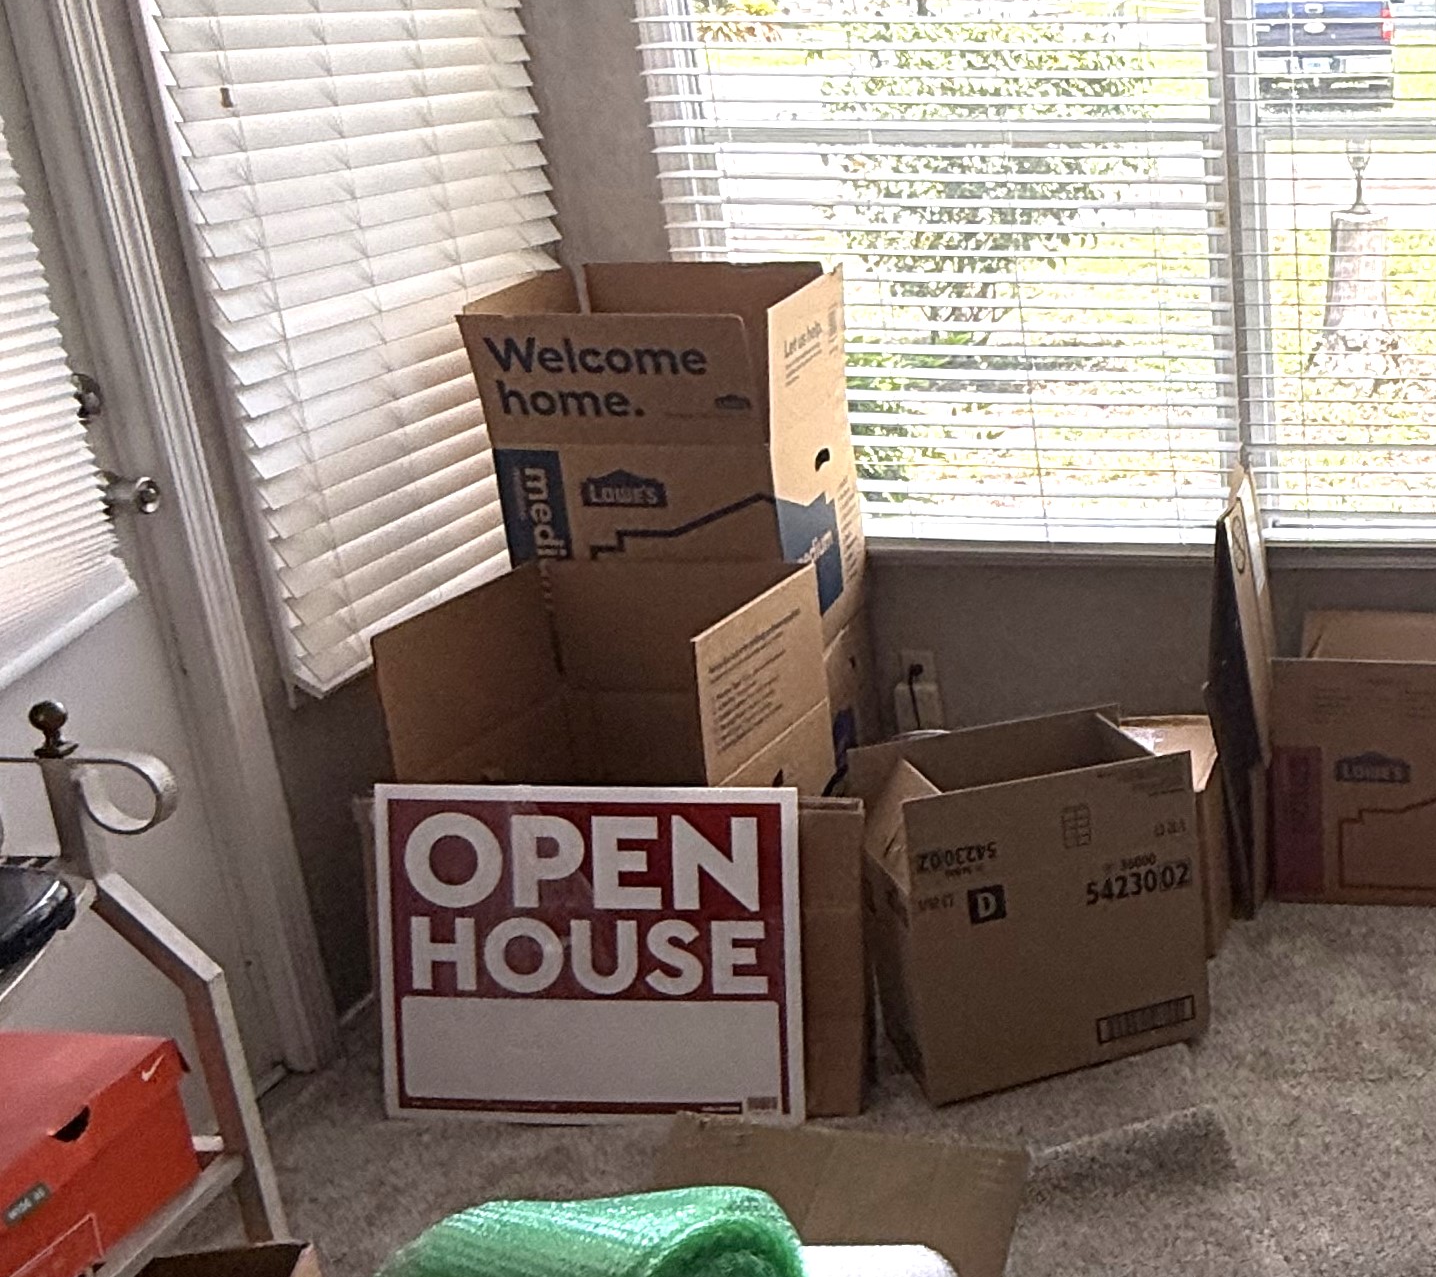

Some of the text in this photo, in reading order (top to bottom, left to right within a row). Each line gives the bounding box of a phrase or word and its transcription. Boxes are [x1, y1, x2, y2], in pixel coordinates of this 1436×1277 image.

[484, 336, 708, 377] Welcome
[497, 381, 645, 418] home.
[523, 466, 568, 560] medi
[404, 811, 761, 913] OPEN
[1085, 860, 1191, 907] 5423002
[976, 892, 998, 919] D
[410, 919, 769, 995] HOUSE
